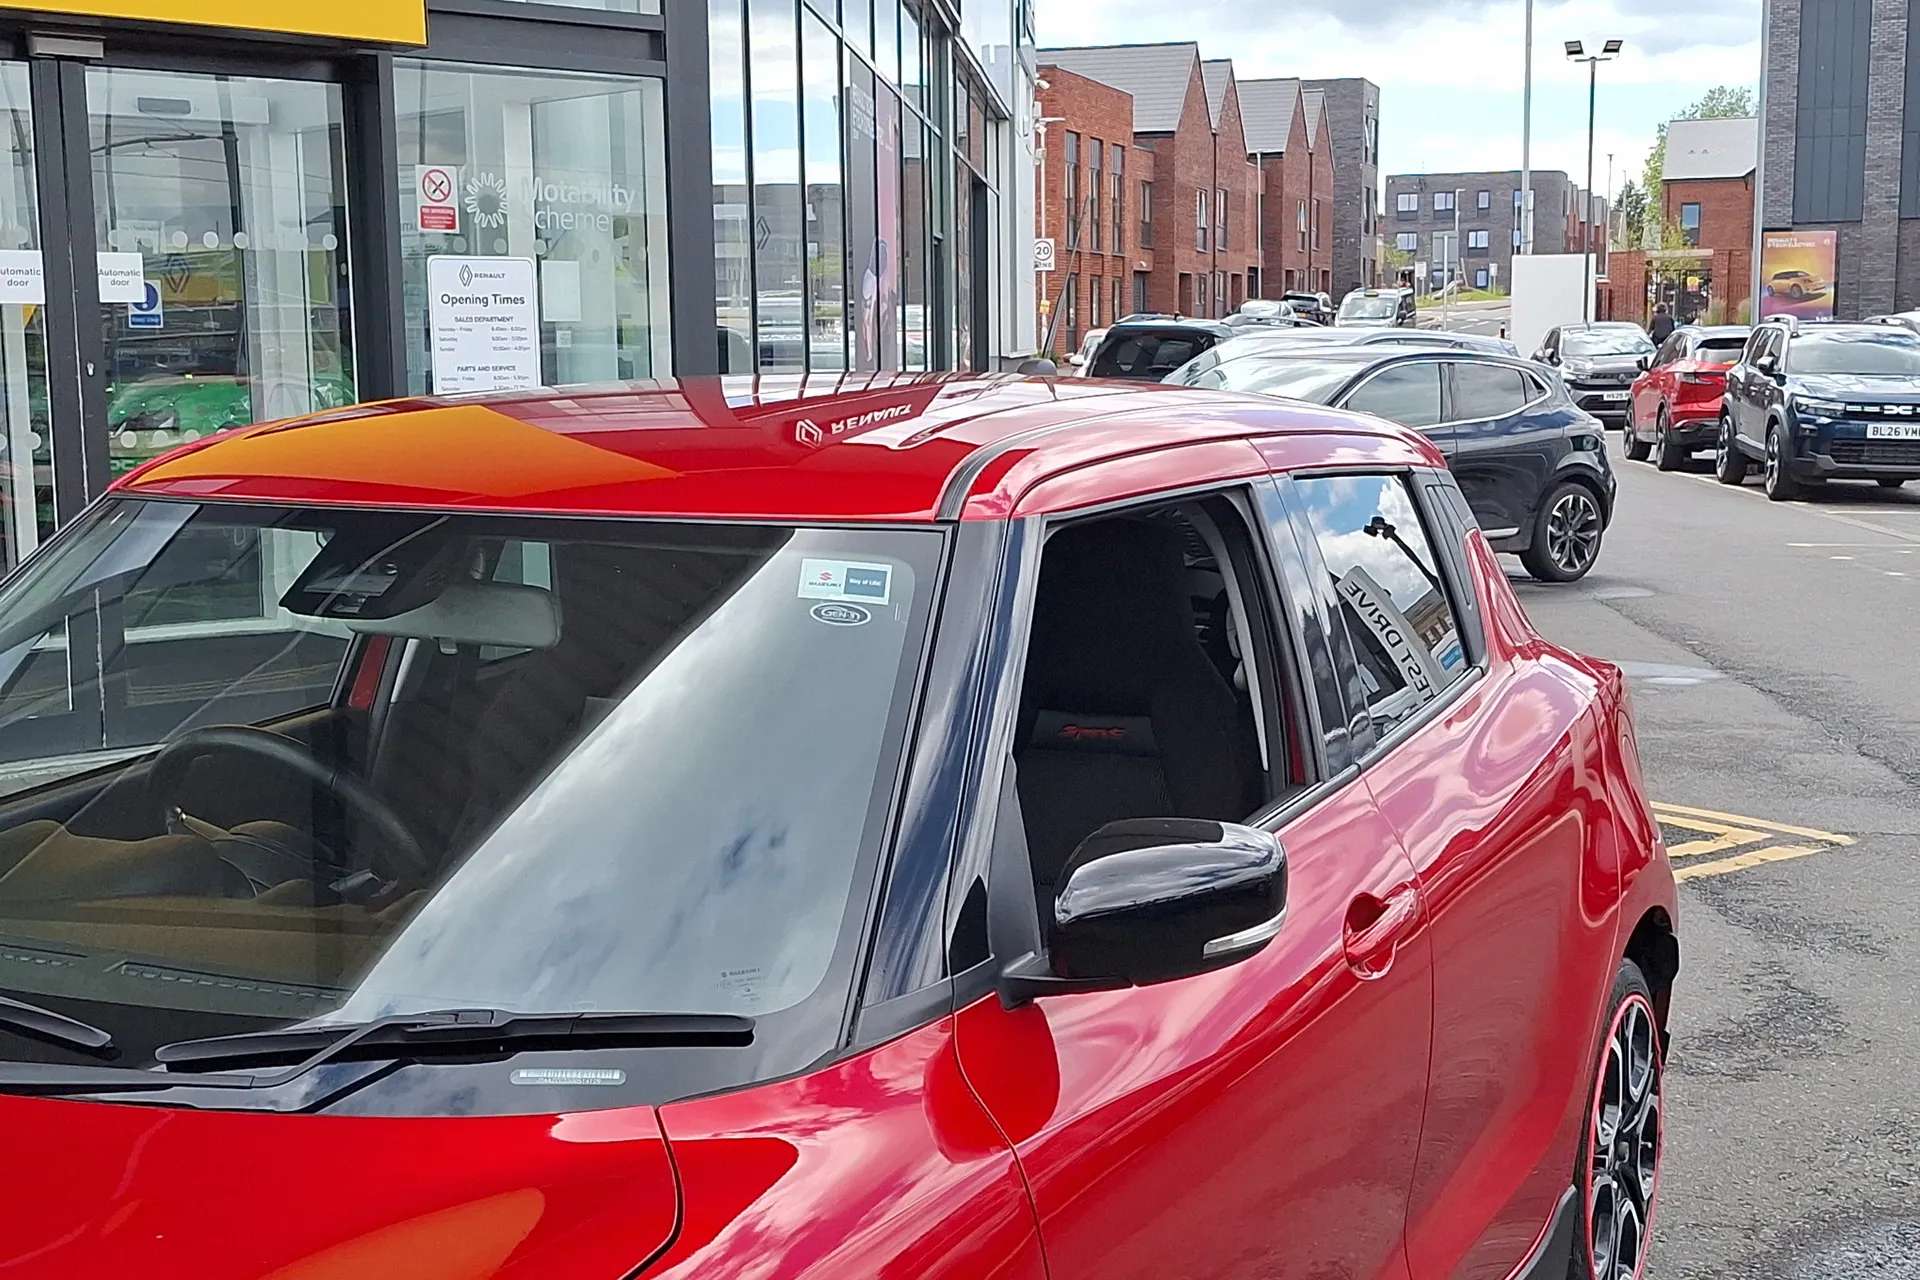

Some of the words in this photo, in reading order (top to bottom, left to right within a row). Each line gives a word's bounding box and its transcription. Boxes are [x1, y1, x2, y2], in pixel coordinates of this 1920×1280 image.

[520, 177, 635, 212] Motability
[534, 205, 609, 231] cheme
[1036, 246, 1049, 255] 20
[0, 267, 41, 276] utomatic
[99, 269, 141, 277] Automatic
[7, 279, 29, 287] door
[110, 278, 130, 286] door
[441, 293, 489, 307] Opening
[491, 294, 525, 305] Times
[1872, 426, 1901, 437] BL26
[1904, 427, 1920, 437] VM
